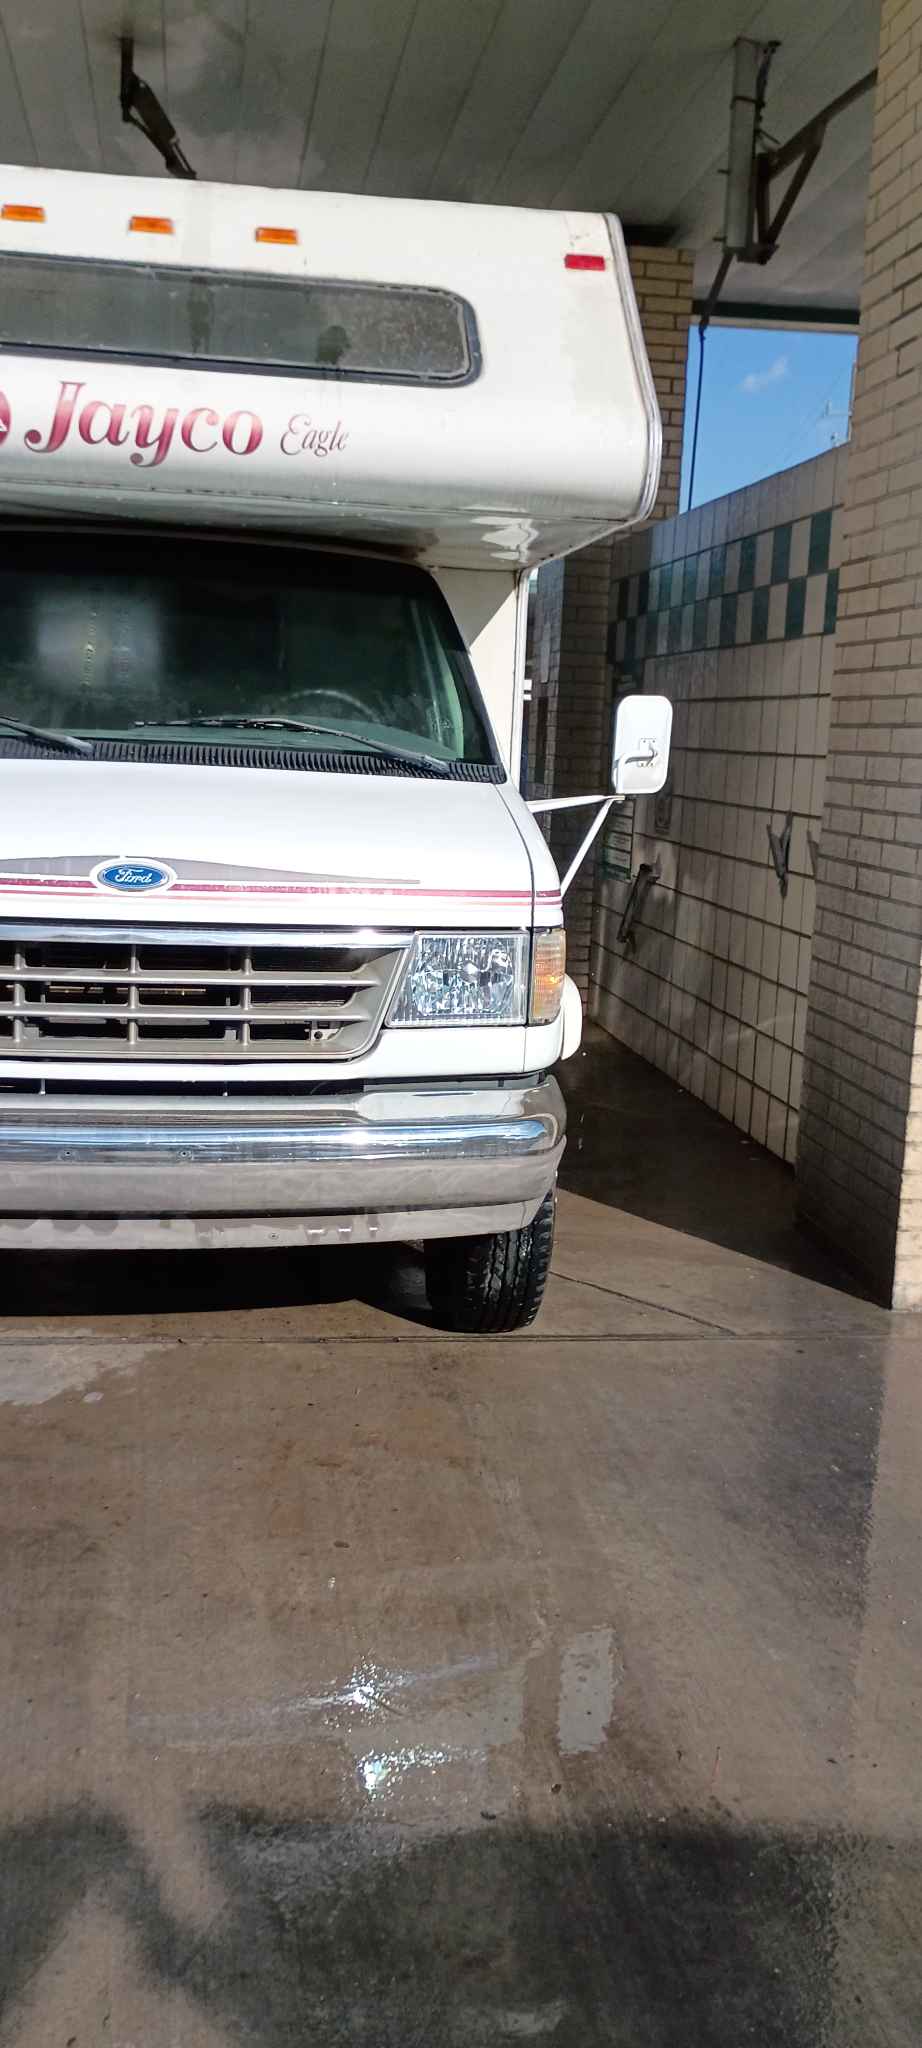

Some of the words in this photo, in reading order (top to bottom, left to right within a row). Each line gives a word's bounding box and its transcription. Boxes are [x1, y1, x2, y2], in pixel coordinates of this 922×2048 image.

[24, 380, 264, 468] Jayco
[280, 414, 349, 457] Eagle
[115, 868, 152, 883] Ford
